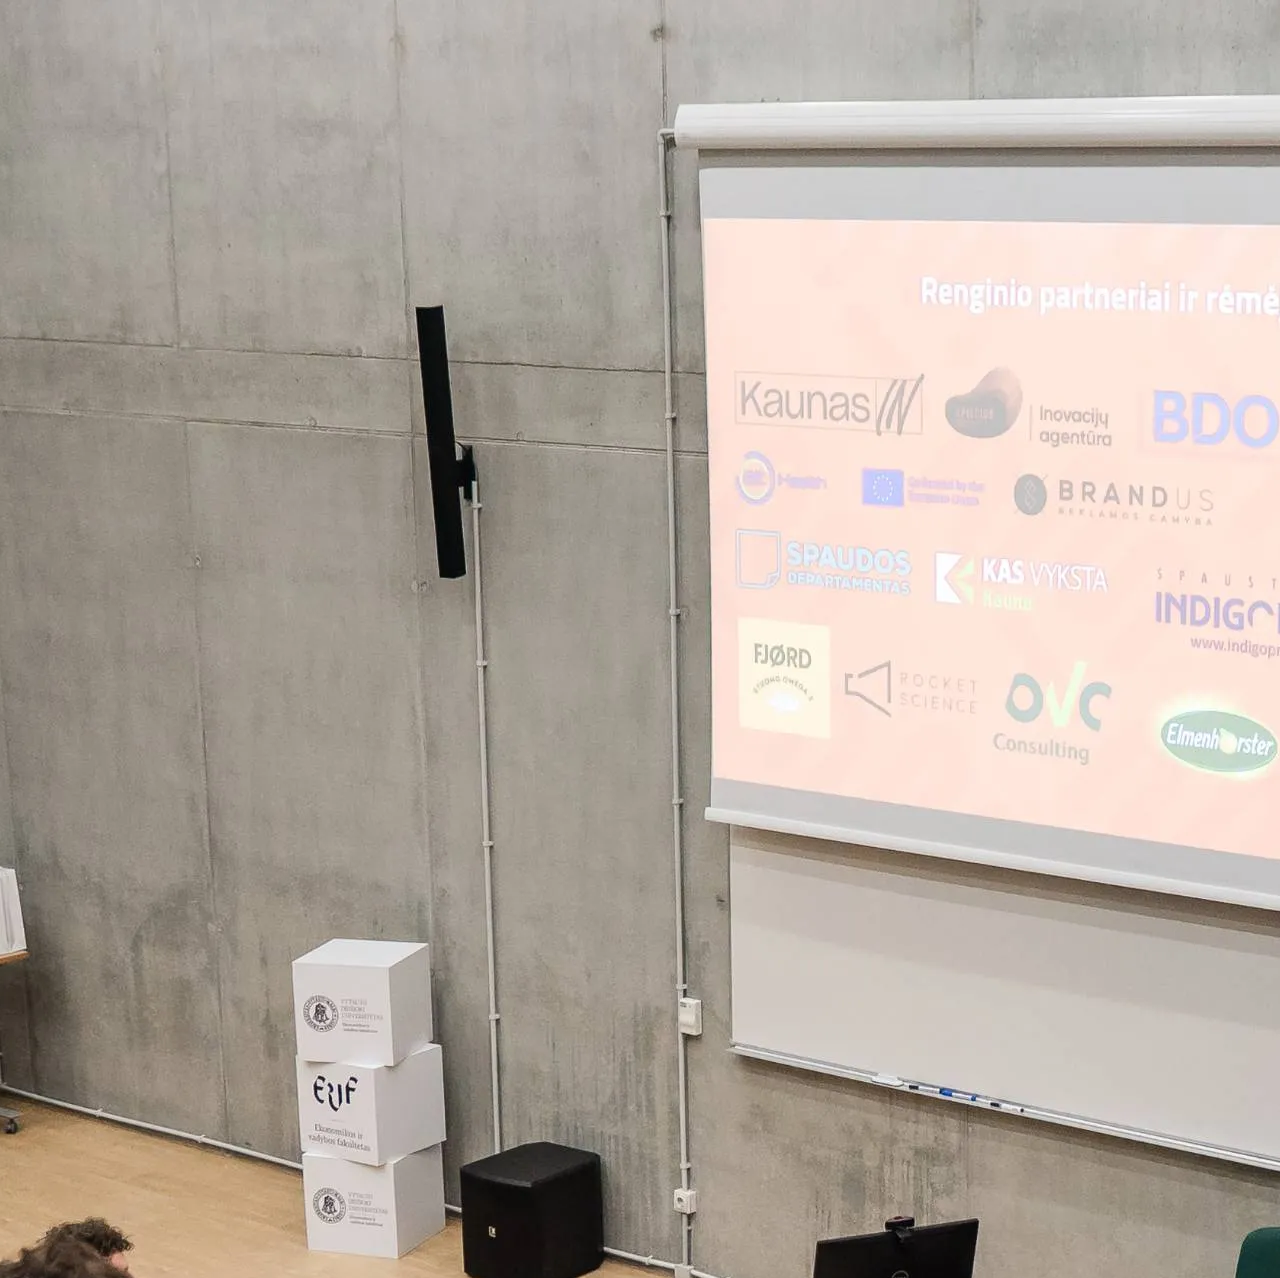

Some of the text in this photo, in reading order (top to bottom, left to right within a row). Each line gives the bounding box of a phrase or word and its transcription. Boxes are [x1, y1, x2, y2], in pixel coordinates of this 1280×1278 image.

[921, 276, 1032, 313] Renginio
[1039, 279, 1171, 315] partneriai
[1179, 283, 1197, 313] ir
[740, 380, 870, 424] Kaunas
[1039, 404, 1109, 430] Inovacijų
[1153, 390, 1280, 448] BDO
[1039, 428, 1112, 448] agentūra
[1059, 480, 1215, 512] BRANDUS
[786, 541, 912, 576] SPAUDOS
[786, 572, 912, 595] DEPARTAMENTAS
[982, 557, 1109, 593] KAS VYKSTA
[753, 642, 812, 669] FJØRD
[900, 671, 978, 693] ROCKET
[900, 690, 978, 715] SCIENCE
[993, 732, 1090, 766] Consulting
